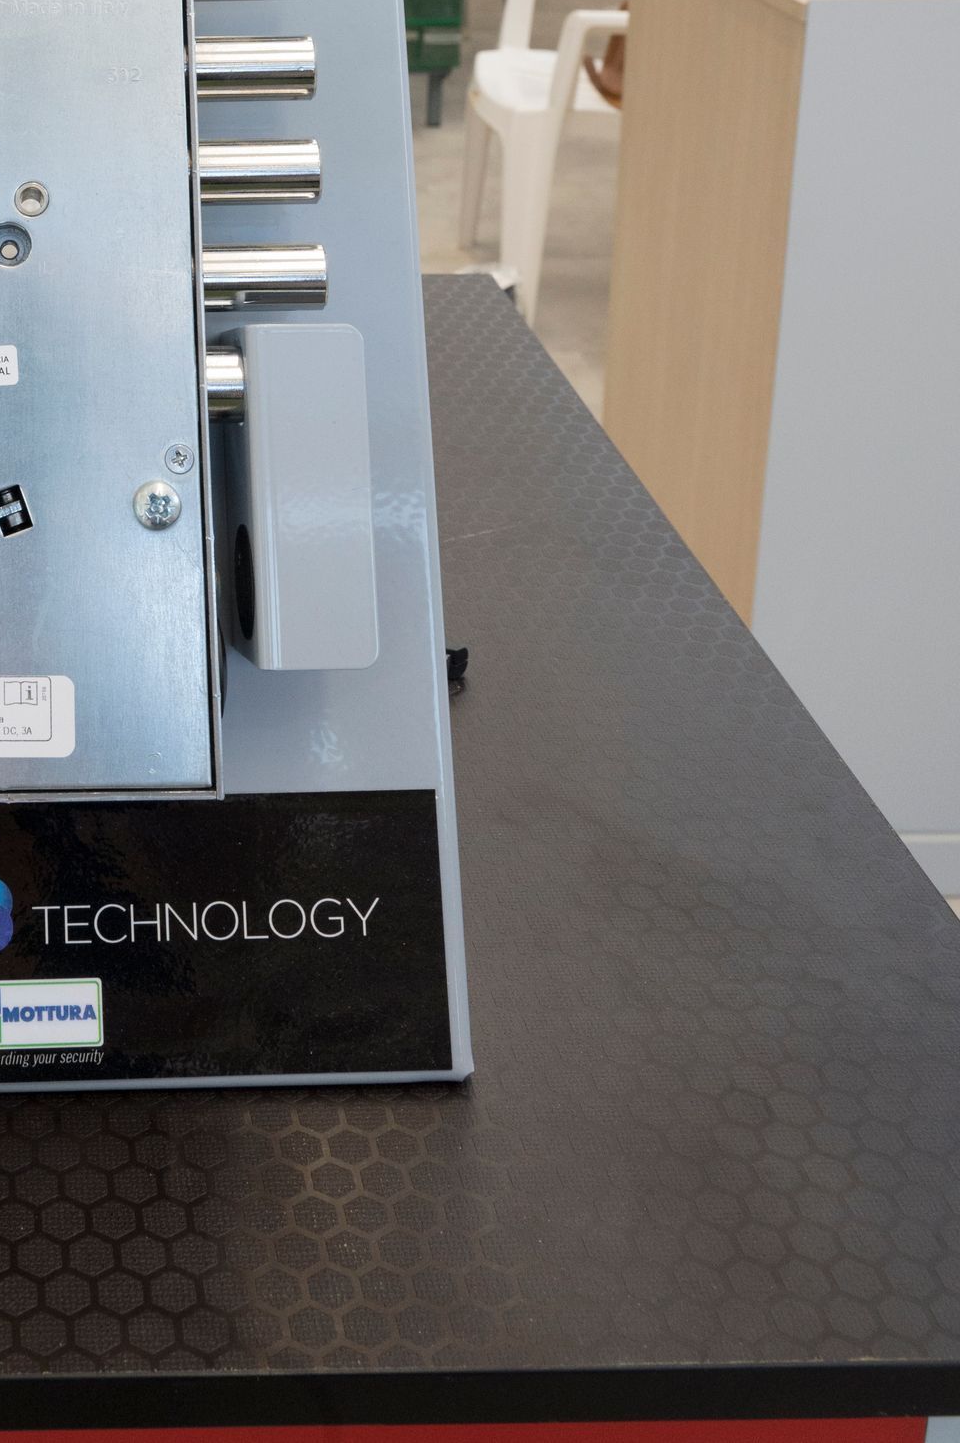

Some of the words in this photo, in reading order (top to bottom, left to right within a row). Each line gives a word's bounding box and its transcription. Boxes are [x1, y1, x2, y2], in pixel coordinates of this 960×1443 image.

[21, 726, 33, 736] 3A
[32, 897, 379, 946] TECHNOLOGY
[2, 1004, 97, 1023] MOTTURA
[33, 1052, 58, 1067] your
[59, 1048, 104, 1066] security
